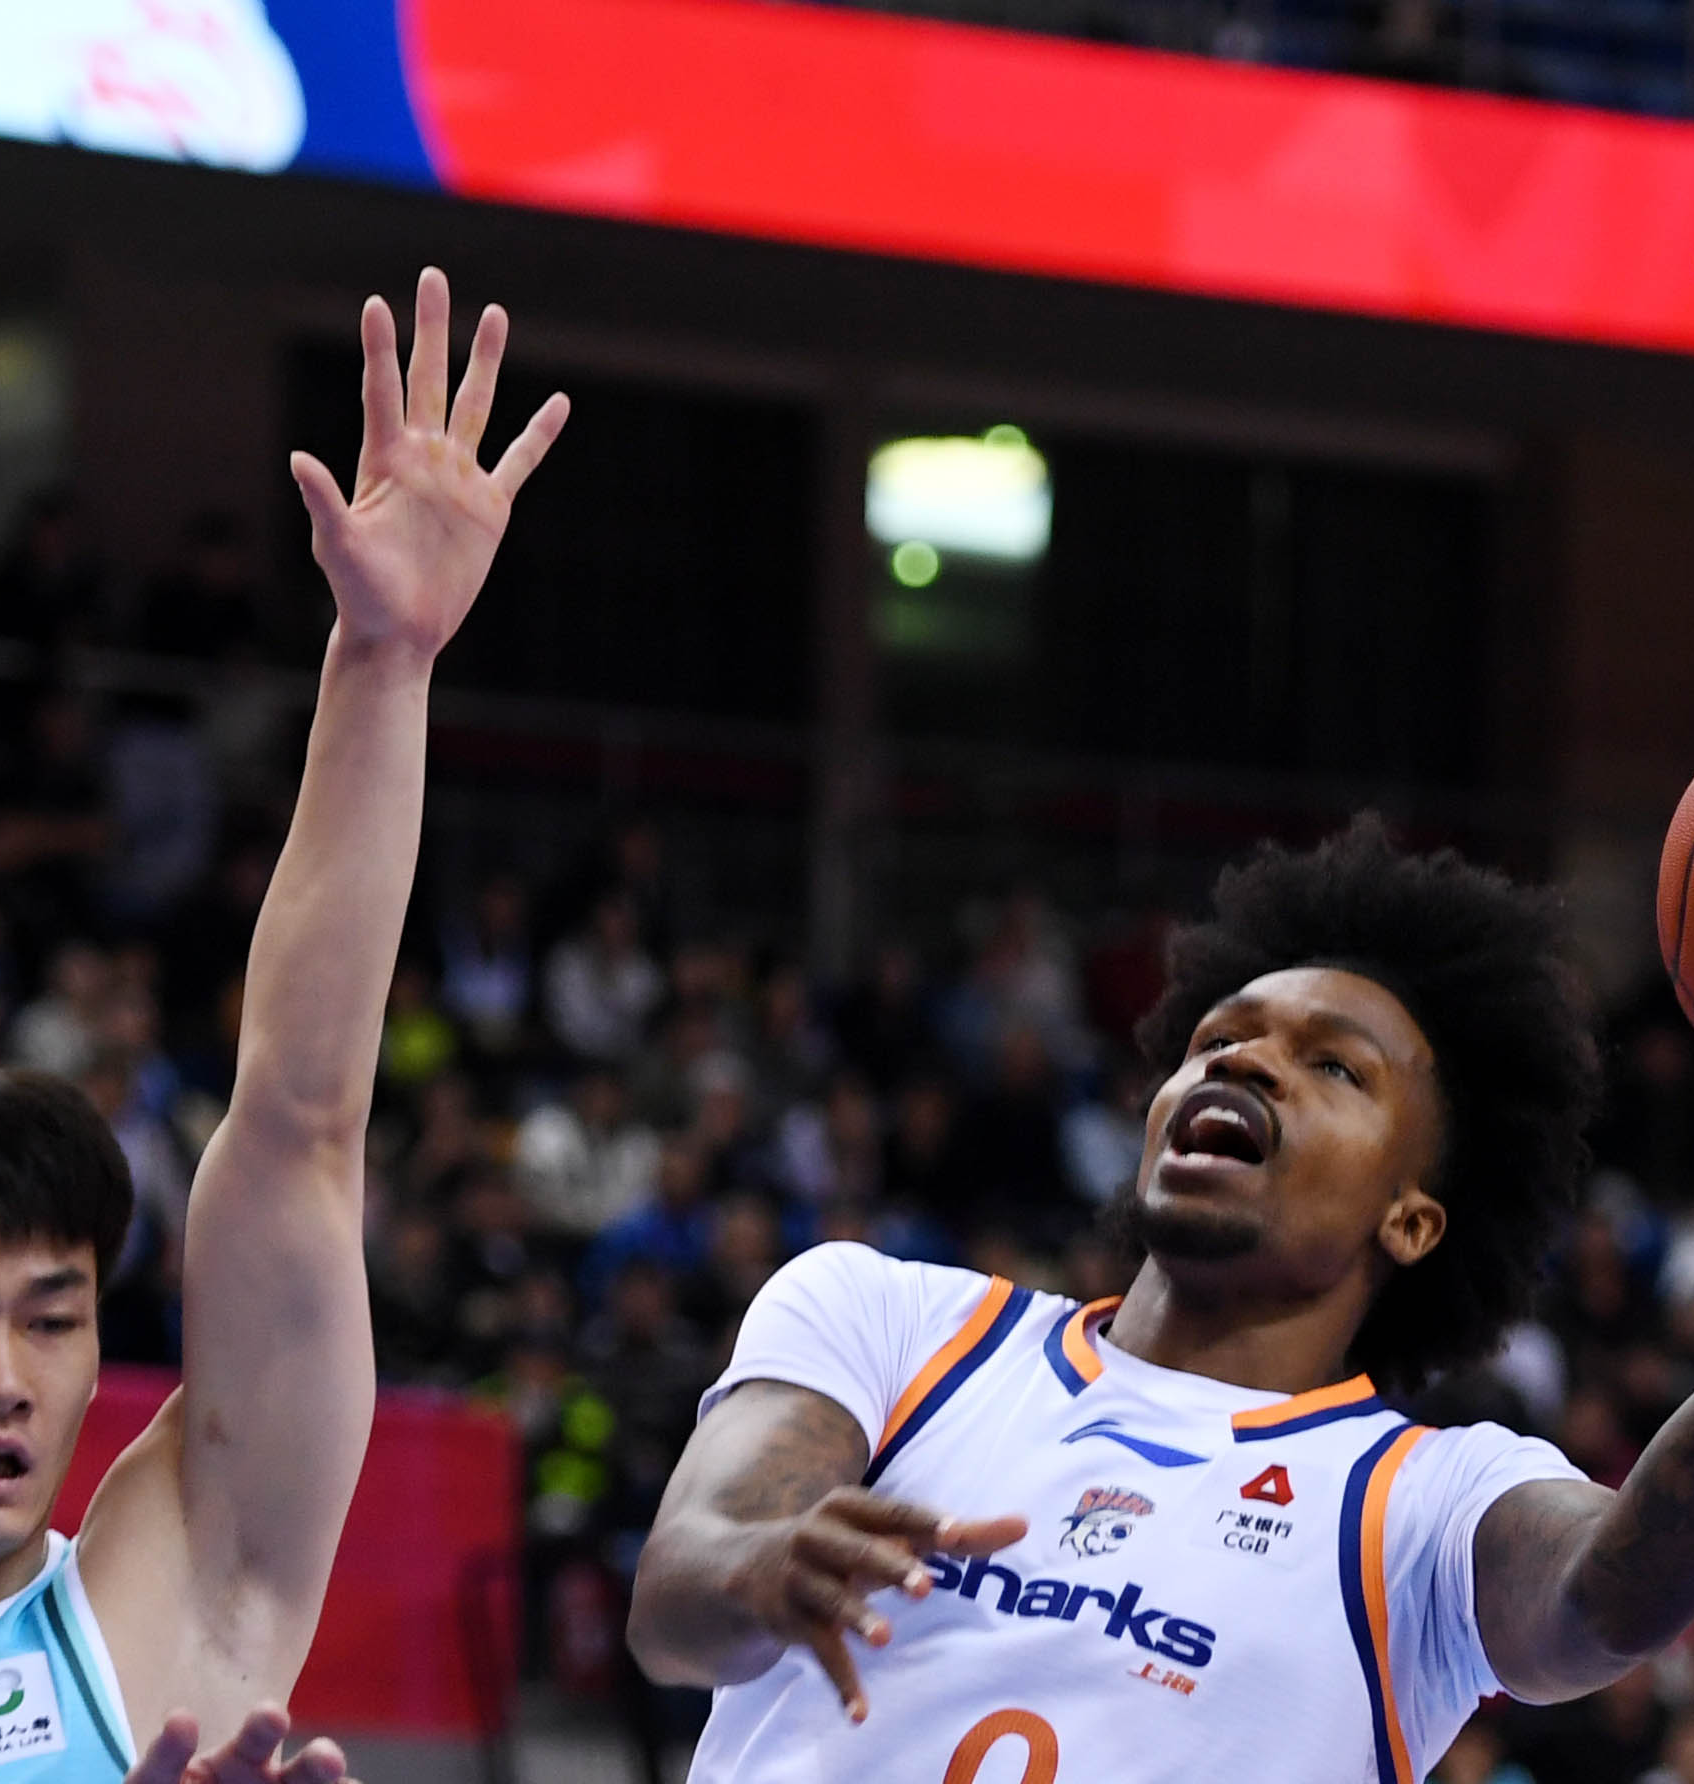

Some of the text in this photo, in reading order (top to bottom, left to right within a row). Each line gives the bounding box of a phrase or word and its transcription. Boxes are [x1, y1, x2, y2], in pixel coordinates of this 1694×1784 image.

[1216, 1508, 1293, 1539] 广发银行
[1223, 1530, 1270, 1554] CGB
